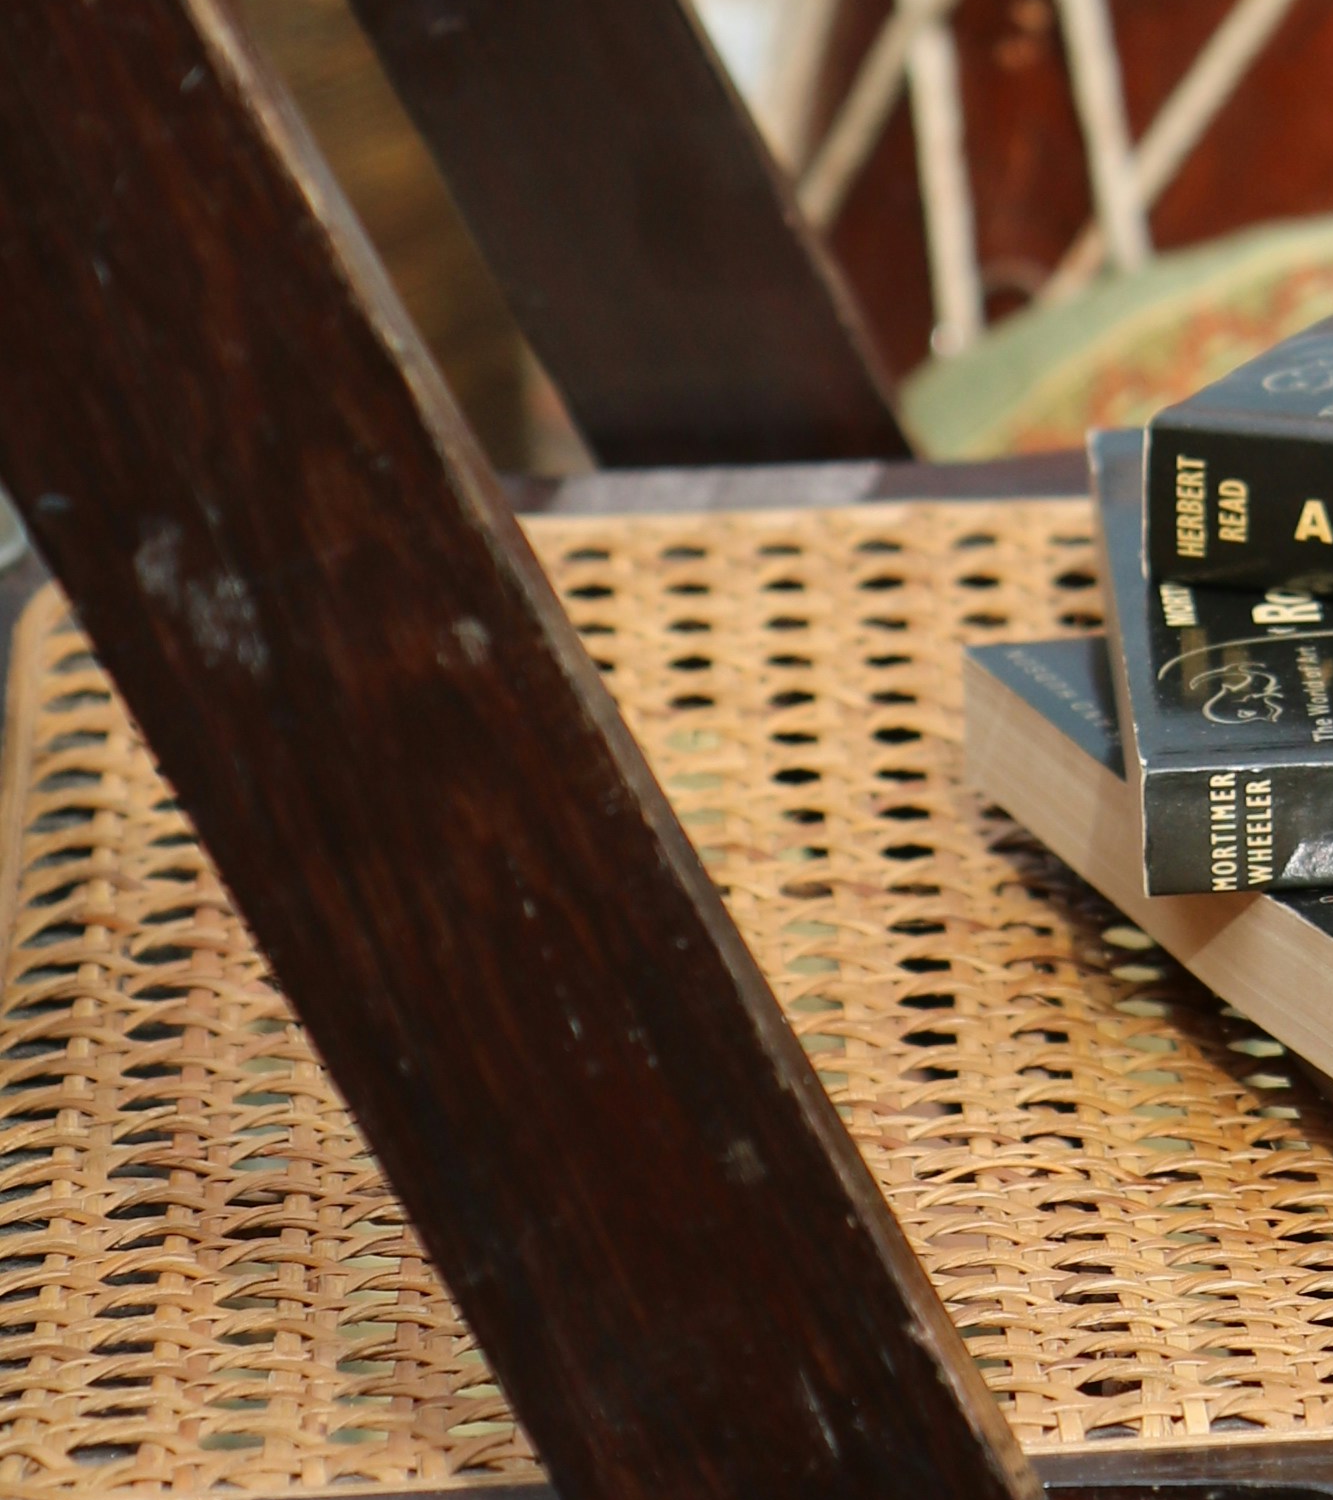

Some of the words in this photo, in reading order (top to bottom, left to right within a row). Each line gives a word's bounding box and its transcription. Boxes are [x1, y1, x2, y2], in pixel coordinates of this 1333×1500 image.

[1176, 455, 1206, 558] HERBERT
[1218, 478, 1248, 543] READ
[1294, 499, 1333, 544] A
[1301, 681, 1330, 717] World
[1208, 772, 1238, 892] MORTIMER
[1245, 778, 1273, 886] WHEELER
